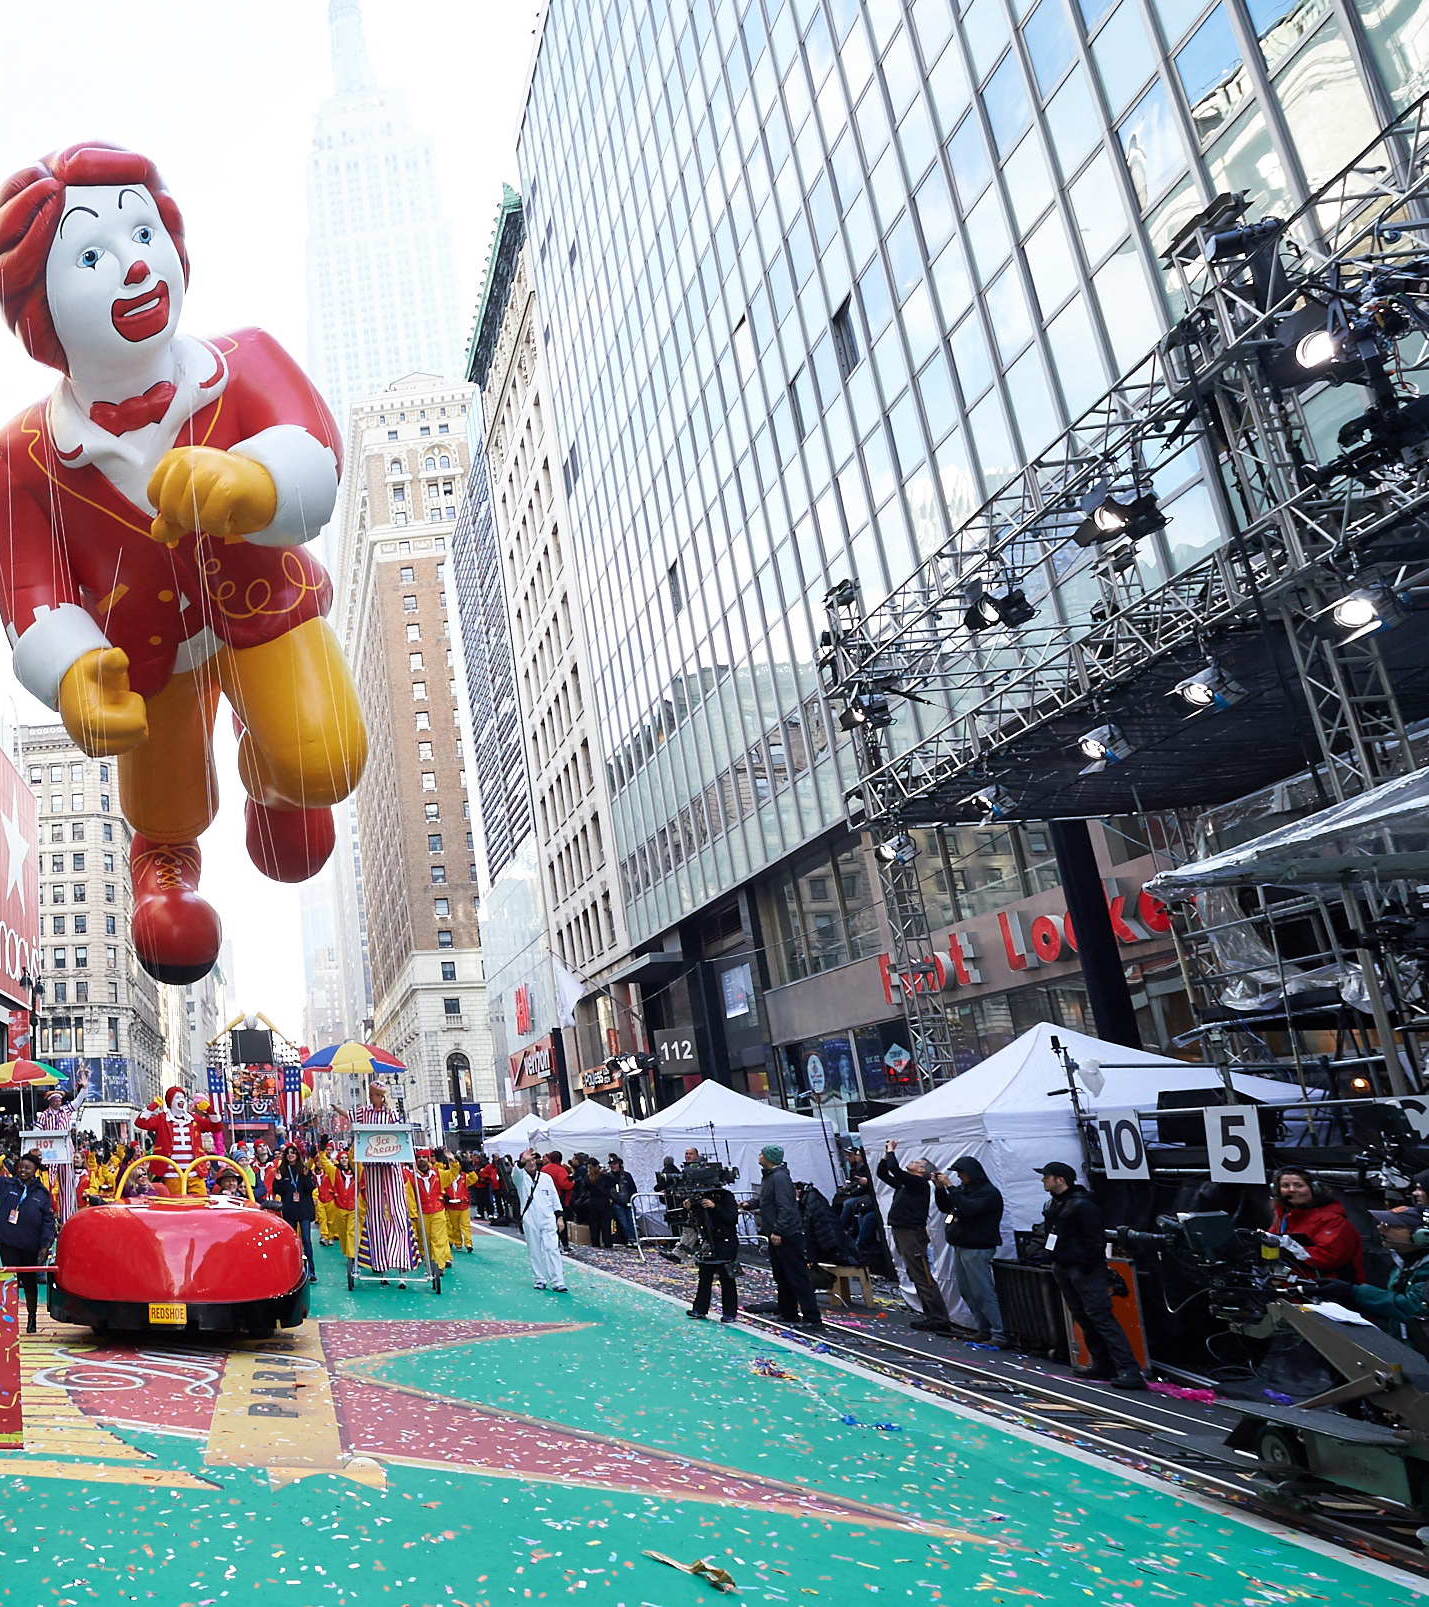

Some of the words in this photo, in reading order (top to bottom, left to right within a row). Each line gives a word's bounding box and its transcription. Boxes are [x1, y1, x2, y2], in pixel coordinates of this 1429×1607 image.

[660, 1039, 694, 1061] 112
[451, 1110, 471, 1127] GP
[35, 1140, 54, 1149] HOT
[376, 1135, 390, 1146] Ice
[1099, 1119, 1144, 1170] 10
[1221, 1115, 1251, 1173] 5
[365, 1145, 402, 1158] Cream
[151, 1307, 185, 1320] REDSHOE
